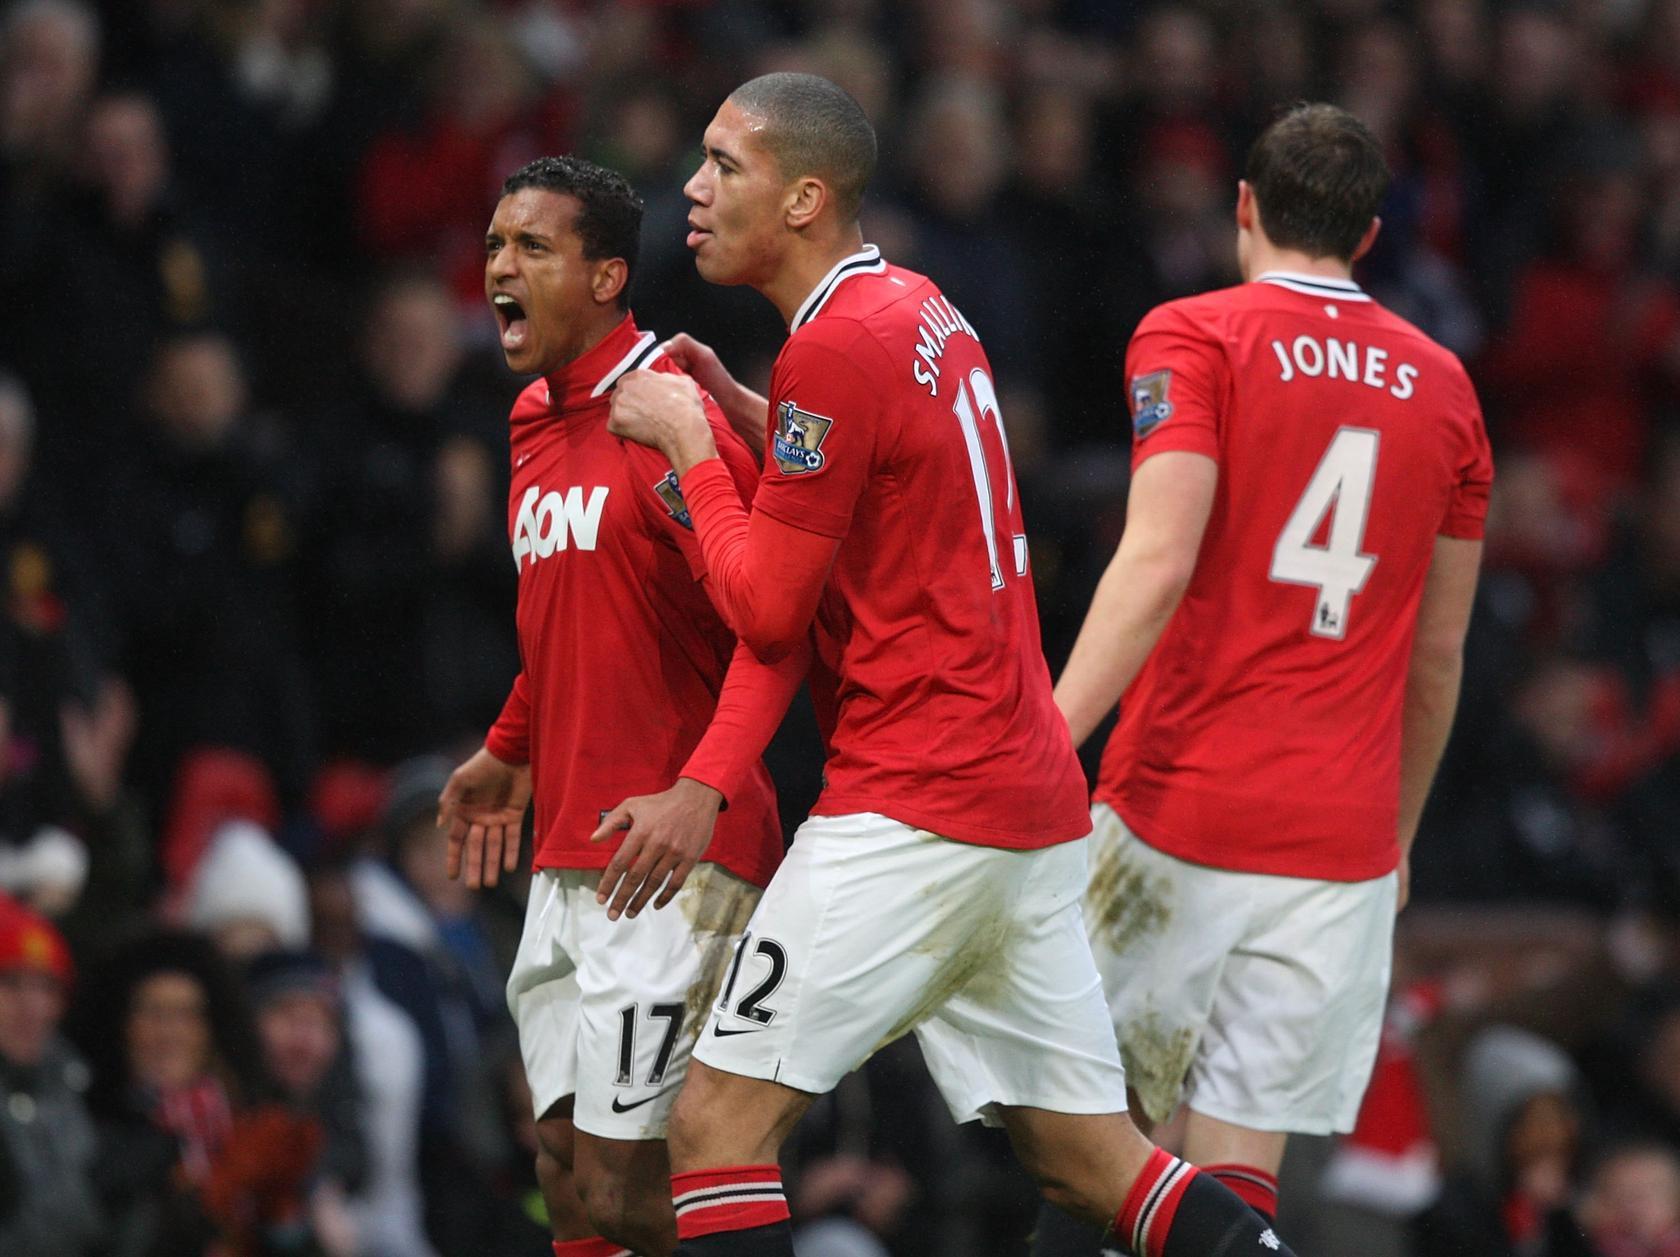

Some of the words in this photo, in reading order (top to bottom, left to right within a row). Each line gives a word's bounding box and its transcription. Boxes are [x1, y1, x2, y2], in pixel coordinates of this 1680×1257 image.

[1271, 334, 1419, 400] JONES
[952, 367, 1028, 591] 12
[512, 485, 609, 575] AON
[1268, 425, 1381, 640] 4
[718, 931, 788, 1028] 12
[613, 1001, 686, 1088] 17
